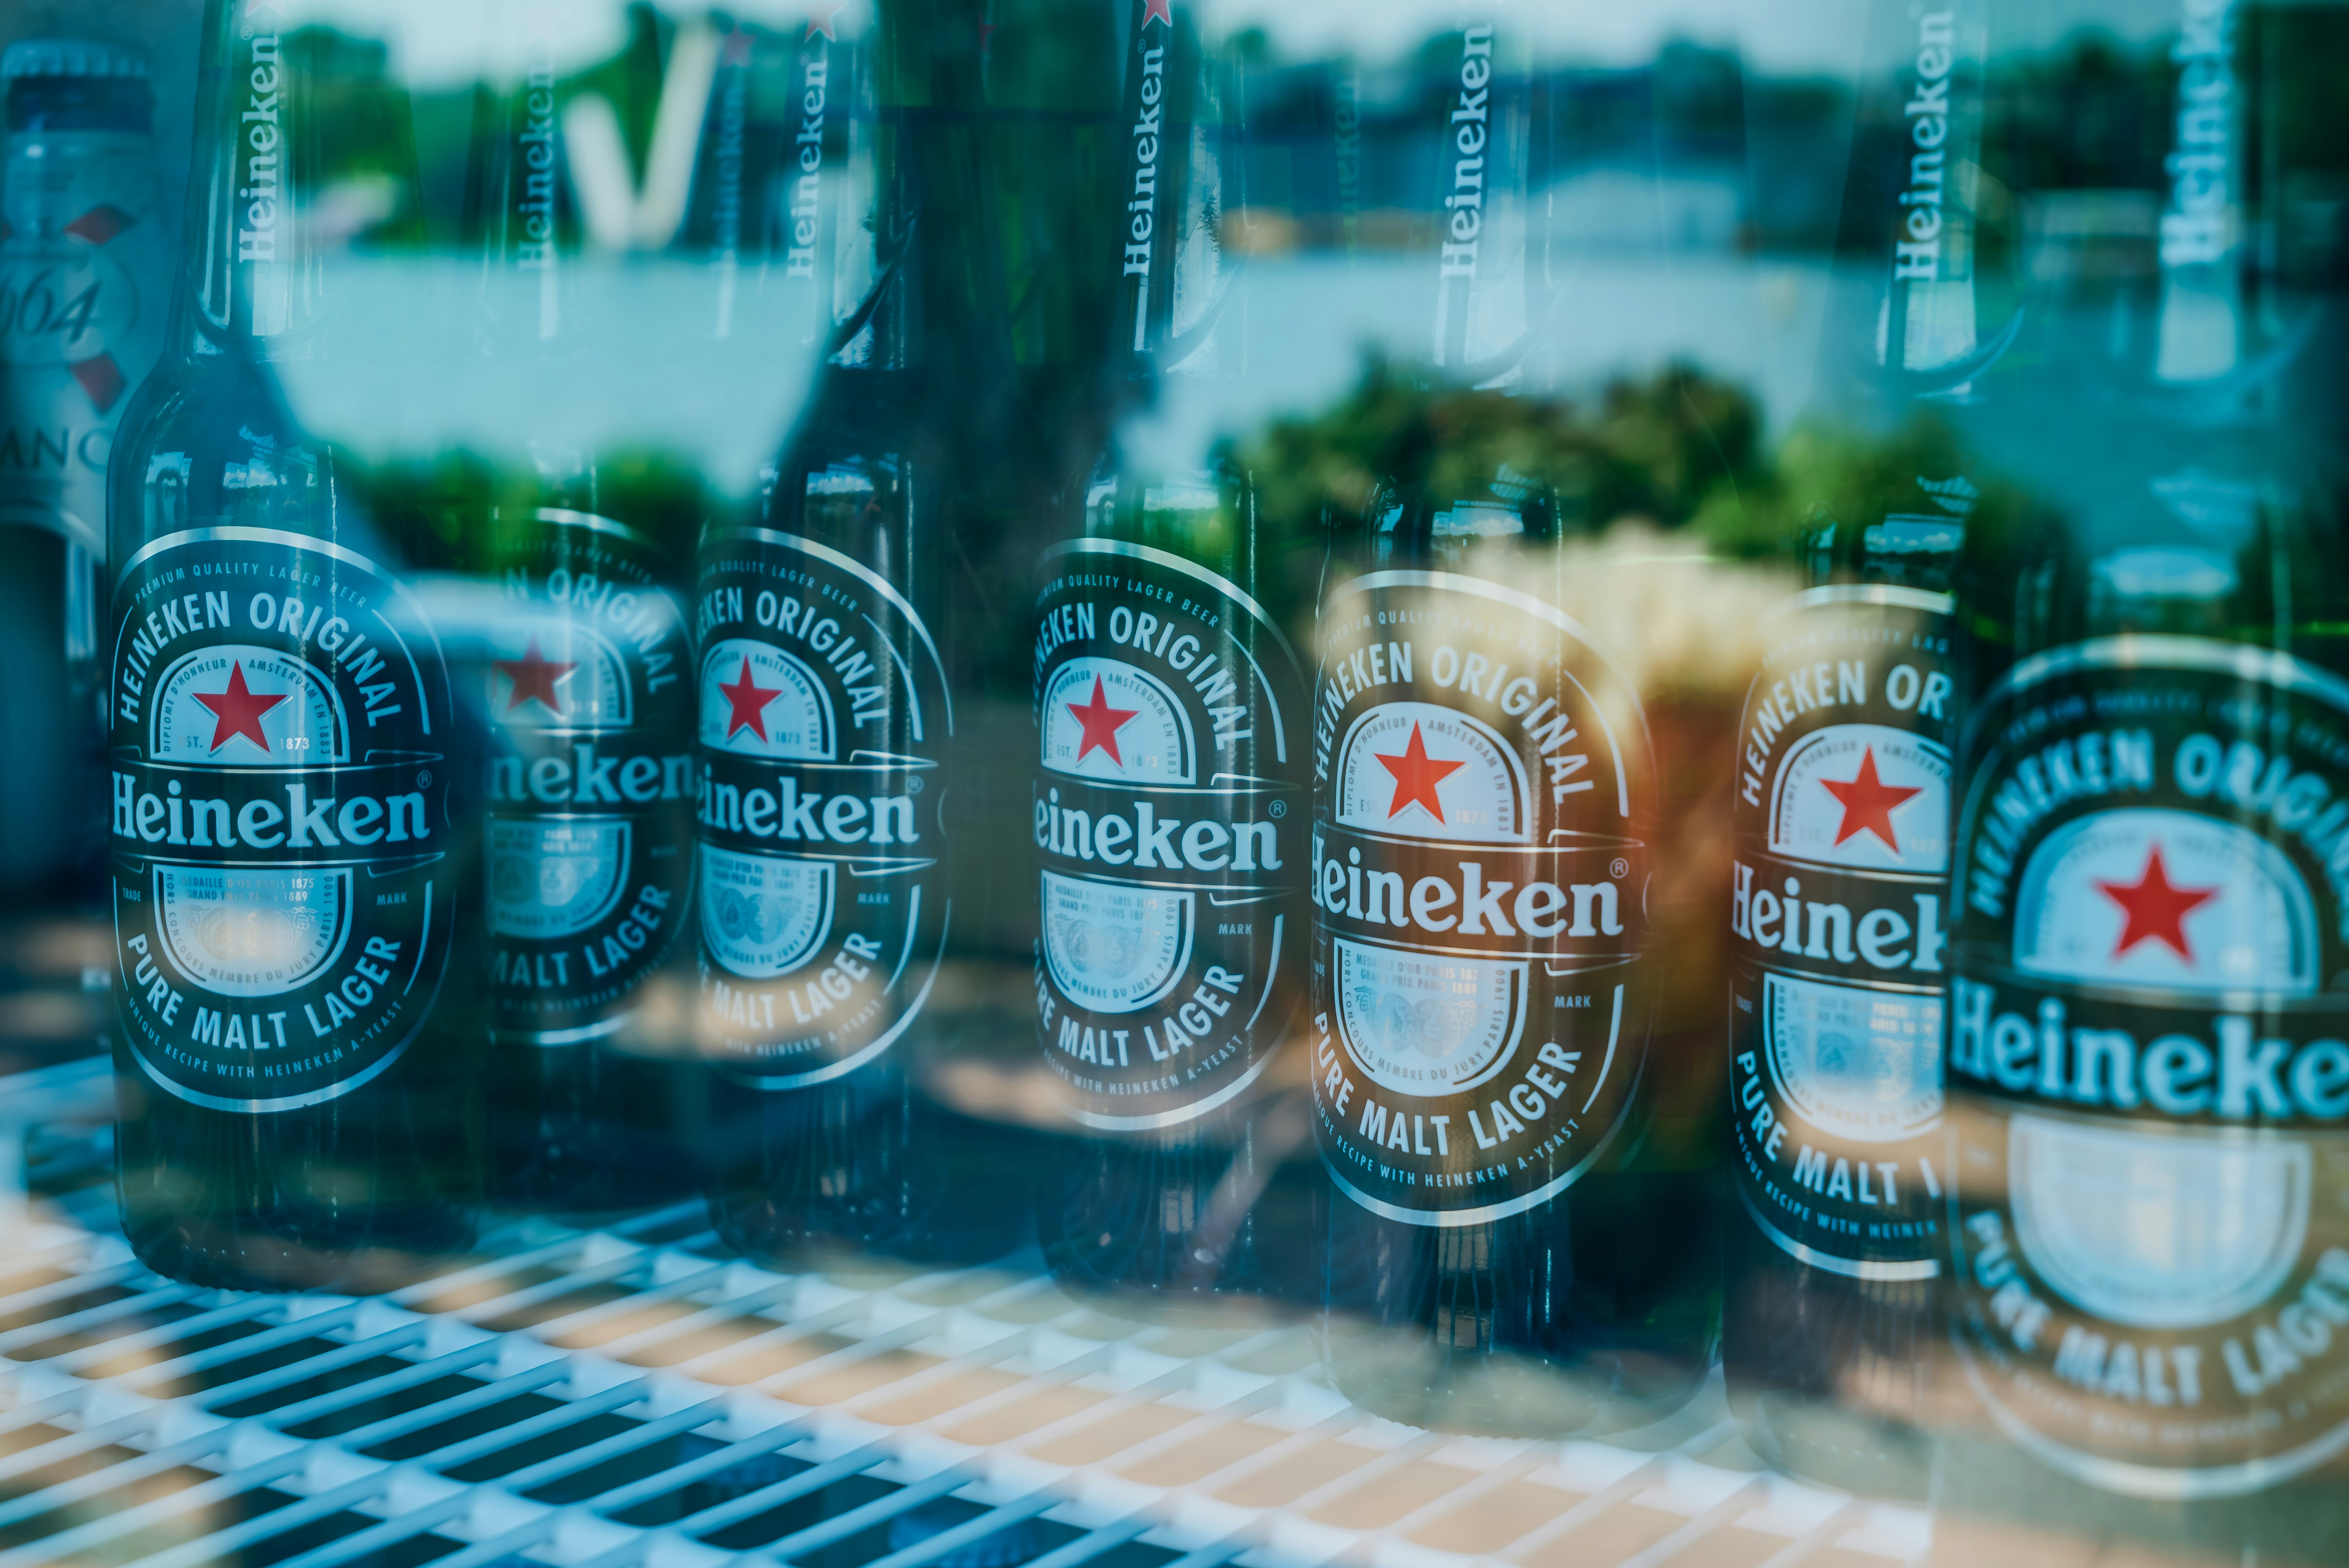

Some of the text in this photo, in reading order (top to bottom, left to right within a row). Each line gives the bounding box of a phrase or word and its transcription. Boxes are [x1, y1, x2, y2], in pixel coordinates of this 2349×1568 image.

[238, 34, 280, 264] Heineken
[787, 60, 828, 280] Heineken
[1124, 45, 1164, 277] Heineken
[1440, 22, 1493, 280] Heineken
[1893, 9, 1954, 282] Heineken
[136, 562, 367, 608] PREMIUM QUALITY LAGER BEER
[772, 565, 815, 588] LAGER
[822, 584, 858, 612] BEER
[1069, 574, 1219, 628] QUALITY LAGER BEER
[120, 590, 402, 728] HEINEKEN ORIGINAL
[756, 590, 889, 729] ORIGINAL
[1110, 606, 1252, 750] ORIGINAL
[164, 658, 330, 754] DIPLOME D'HONNEUR AMSTERDAM EN 1883
[1108, 673, 1167, 717] AMSTERDAM
[1316, 641, 1594, 804] HEINEKEN ORIGINAL
[280, 738, 310, 750] 1873
[1163, 723, 1174, 737] EN
[1167, 745, 1176, 774] 1883
[1428, 719, 1498, 768] AMSTERDAM
[1742, 659, 1953, 807] HEINEKEN OR
[487, 743, 698, 803] neken
[1347, 757, 1357, 816] DIPLOME
[1493, 774, 1506, 790] EN
[112, 770, 431, 848] Heineken
[1033, 787, 1283, 871] eineken
[1498, 799, 1509, 831] 1883
[123, 888, 407, 906] TRADE MARK
[284, 891, 308, 901] 1889
[292, 878, 314, 889] 1875
[324, 876, 333, 903] 1900
[857, 893, 891, 904] MARK
[1312, 832, 1624, 938] Heineken
[169, 912, 205, 970] CONCOURS
[316, 912, 333, 947] PARIS
[584, 884, 671, 977] LAGER
[1113, 988, 1126, 998] DU
[1132, 972, 1157, 994] JURY
[1157, 935, 1173, 970] PARIS
[1166, 899, 1175, 926] 1900
[1218, 924, 1252, 935] MARK
[127, 933, 401, 1050] PURE MALT LAGER
[209, 967, 259, 983] MEMBRE
[267, 970, 282, 980] DU
[289, 950, 317, 974] JURY
[713, 979, 775, 1029] MALT
[788, 933, 882, 1024] LAGER
[1460, 968, 1478, 981] 187
[1058, 1015, 1129, 1066] MALT
[1144, 965, 1244, 1062] LAGER
[1345, 991, 1373, 1060] CONCOURS
[1377, 1058, 1423, 1080] MEMBRE
[1431, 1070, 1447, 1081] DU
[1454, 1051, 1484, 1075] JURY
[1484, 1009, 1503, 1048] PARIS
[1495, 969, 1506, 1001] 1900
[1554, 995, 1591, 1008] MARK
[129, 997, 402, 1077] UNIQUE RECIPE WITH HEINEKEN A-YEAST
[757, 1037, 821, 1056] HEINEKEN
[1074, 1074, 1102, 1093] WITH
[1109, 1074, 1179, 1095] HEINEKEN
[1187, 1034, 1242, 1080] A-YEAST
[1314, 1011, 1582, 1156] PURE MALT LAGER
[1337, 1134, 1373, 1171] RECIPE
[1380, 1164, 1415, 1185] WITH
[1425, 1164, 1508, 1187] HEINEKEN
[1517, 1118, 1579, 1170] A-YEAST
[1737, 1051, 1788, 1162] PURE
[1792, 1144, 1899, 1206] MALT
[1765, 1180, 1811, 1222] RECIPE
[1817, 1212, 1860, 1236] WITH
[2054, 1324, 2203, 1407] MALT
